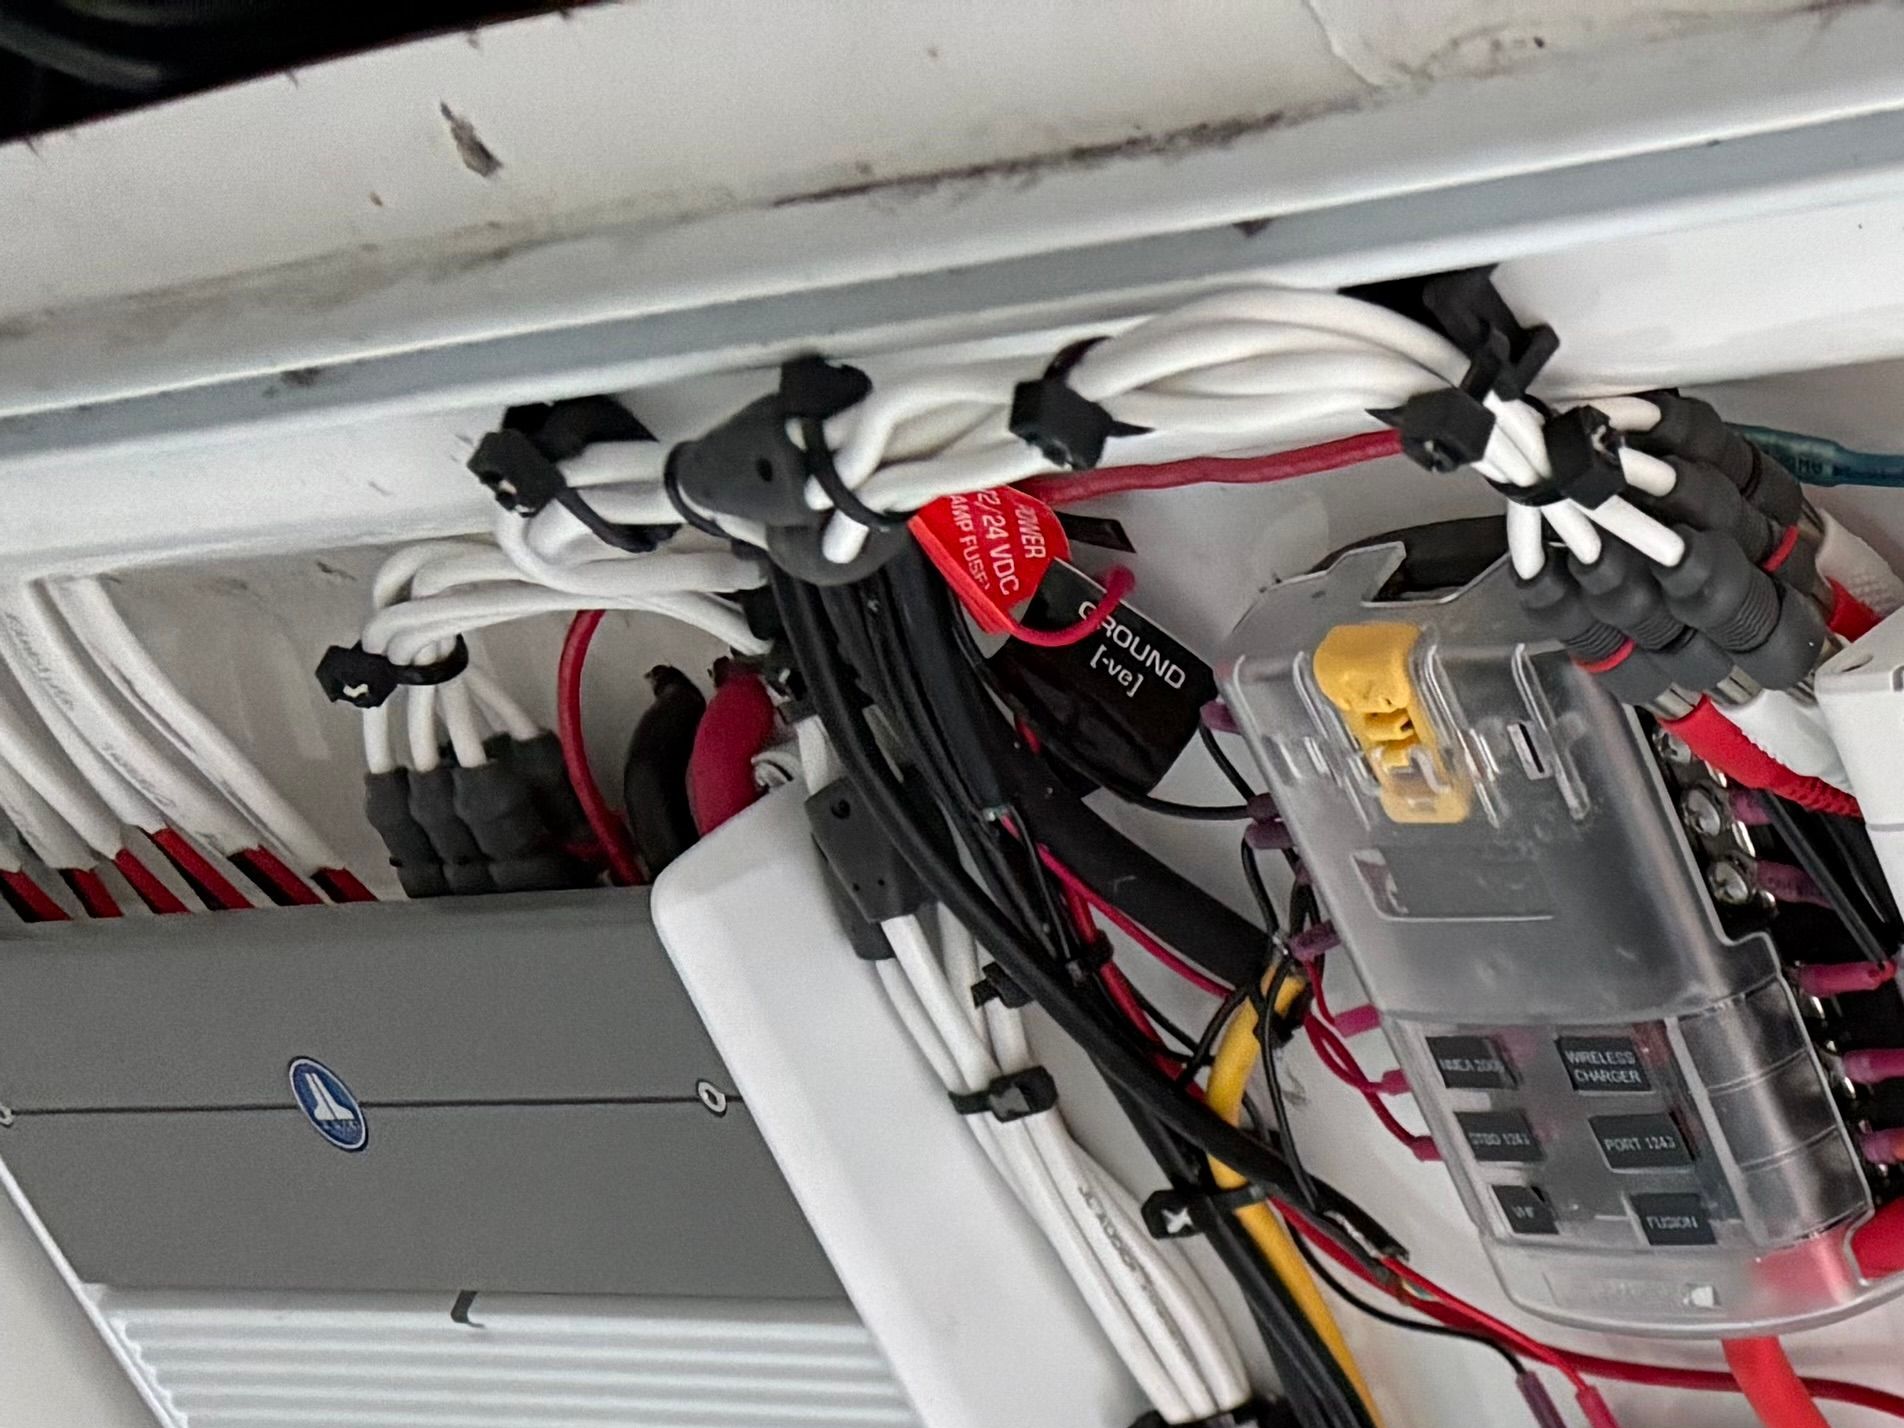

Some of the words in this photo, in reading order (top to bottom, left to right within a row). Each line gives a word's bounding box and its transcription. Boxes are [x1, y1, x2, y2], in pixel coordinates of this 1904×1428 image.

[950, 495, 973, 533] AMP
[1015, 502, 1046, 558] POWER
[989, 545, 1020, 596] VDC
[1090, 644, 1144, 698] [-ve]
[1565, 1050, 1636, 1066] WIRELESS
[1573, 1068, 1641, 1084] CHARGER
[1604, 1138, 1641, 1151] PORT
